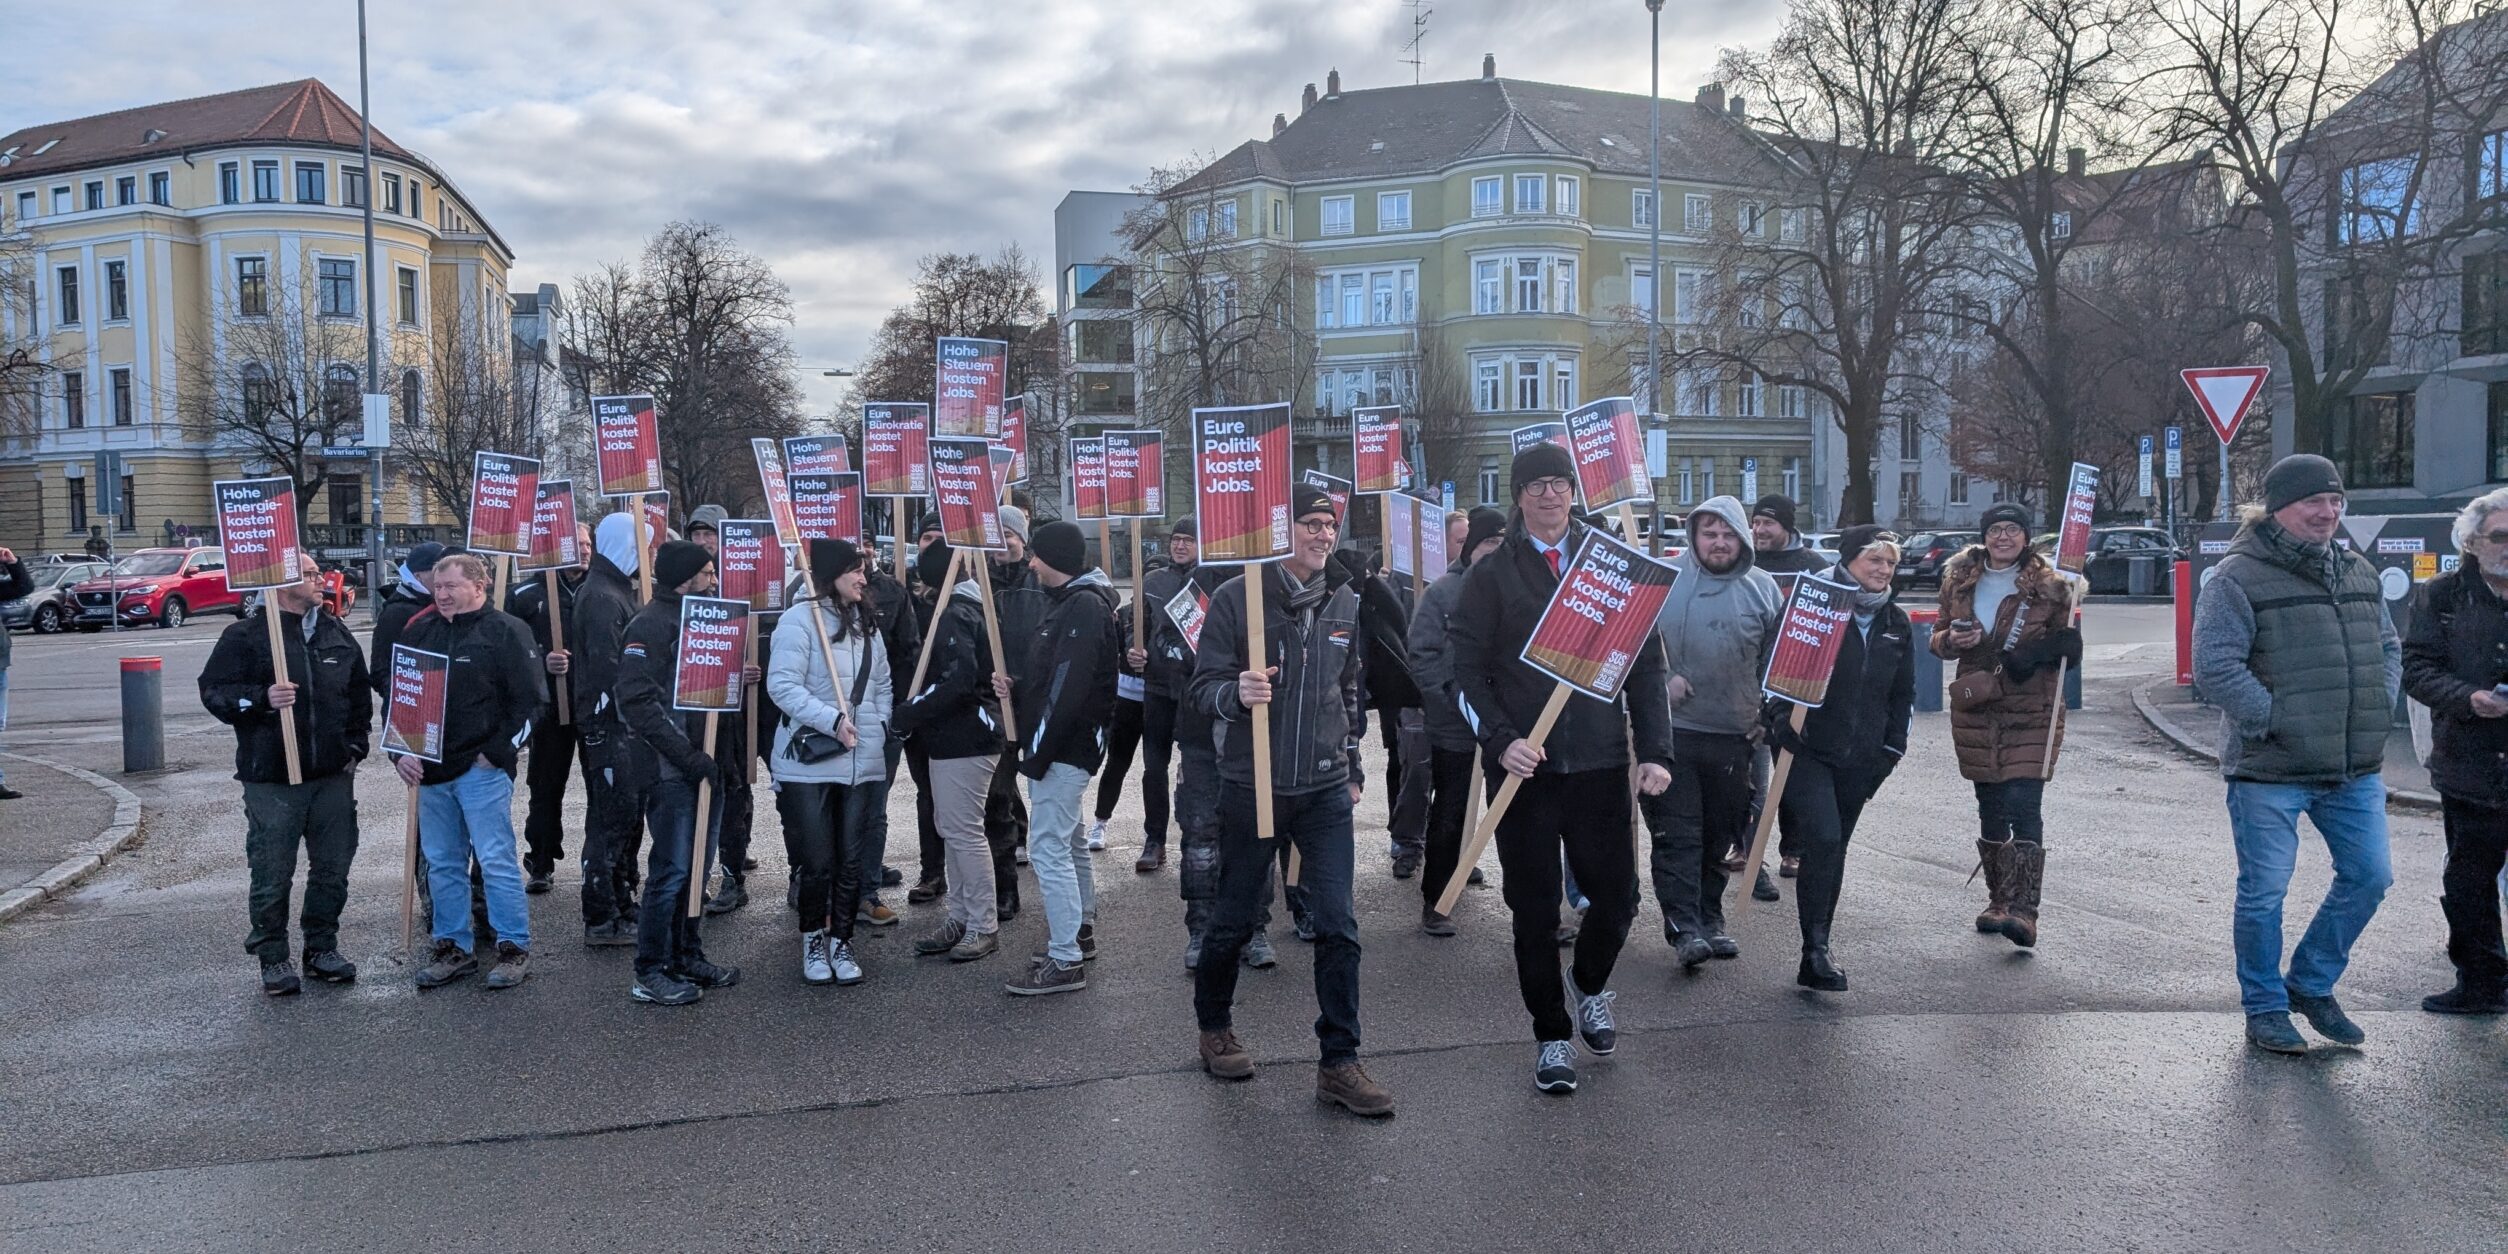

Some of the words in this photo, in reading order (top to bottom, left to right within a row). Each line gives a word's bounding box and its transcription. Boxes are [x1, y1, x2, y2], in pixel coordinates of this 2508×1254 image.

[944, 344, 979, 357] Hohe
[944, 358, 994, 372] Steuern
[943, 372, 987, 386] kosten
[943, 386, 977, 399] Jobs.
[600, 404, 627, 414] Eure
[869, 409, 892, 419] Eure
[601, 414, 638, 426] Politik
[1358, 413, 1380, 422] Eure
[1571, 411, 1598, 428] Eure
[869, 420, 924, 430] Bürokratie
[1203, 419, 1245, 435] Eure
[1574, 419, 1614, 440] Politik
[602, 427, 639, 439] kostet
[869, 431, 902, 441] kostet
[1360, 433, 1388, 443] kostet
[1517, 431, 1543, 443] Hohe
[2169, 430, 2178, 447] P
[603, 441, 635, 451] Jobs.
[791, 442, 822, 454] Hohe
[869, 442, 897, 452] Jobs.
[1076, 443, 1104, 453] Hohe
[1108, 436, 1129, 447] Eure
[1204, 436, 1262, 455] Politik
[1576, 431, 1617, 453] kostet
[2142, 438, 2149, 453] P
[323, 448, 367, 456] Bavariaring
[760, 446, 778, 458] Ho
[933, 446, 964, 459] Hohe
[1108, 447, 1139, 457] Politik
[1360, 444, 1384, 454] Jobs.
[793, 454, 838, 466] Steuern
[1077, 455, 1105, 465] Steu
[1581, 447, 1613, 465] Jobs.
[482, 460, 511, 472] Eure
[935, 462, 981, 475] Steuern
[1109, 458, 1139, 468] kostet
[1205, 456, 1262, 474] kostet
[1746, 459, 1753, 471] P
[1078, 466, 1105, 476] koste
[1109, 469, 1135, 479] Jobs.
[481, 471, 520, 485] Politik
[938, 477, 977, 491] kosten
[1079, 478, 1105, 488] Jobs
[1309, 476, 1328, 489] Eure
[480, 483, 518, 498] kostet
[794, 480, 827, 490] Hohe
[1206, 476, 1254, 494] Jobs.
[1444, 483, 1452, 492] P
[223, 487, 261, 500] Hohe
[795, 491, 846, 503] Energie-
[942, 492, 972, 506] Jobs.
[224, 499, 283, 514] Energie-
[479, 497, 511, 509] Jobs.
[536, 500, 562, 510] uern
[796, 504, 836, 514] kosten
[534, 512, 557, 523] sten
[1272, 506, 1287, 521] SOS
[2071, 511, 2092, 525] Job
[226, 514, 274, 527] kosten
[797, 516, 836, 527] kosten
[228, 528, 275, 540] kosten
[533, 526, 551, 535] bs.
[726, 526, 752, 536] Eure
[800, 529, 829, 539] Jobs.
[230, 541, 268, 554] Jobs.
[726, 538, 762, 548] Politik
[726, 550, 762, 560] kostet
[1589, 542, 1629, 572] Eure
[726, 561, 756, 571] Jobs.
[1581, 558, 1635, 597] Politik
[1571, 574, 1627, 613] kostet
[1800, 582, 1829, 602] Eure
[690, 604, 728, 620] Hohe
[1173, 601, 1191, 620] Eure
[1562, 595, 1606, 625] Jobs.
[689, 620, 739, 636] Steuern
[1791, 610, 1834, 635] kostet
[687, 635, 732, 651] kosten
[1787, 626, 1821, 647] Jobs.
[396, 653, 416, 666] Eure
[686, 652, 723, 666] Jobs.
[1608, 651, 1628, 667] SOS
[396, 666, 424, 682] Politik
[395, 678, 423, 696] kostet
[395, 692, 417, 707] Jobs.
